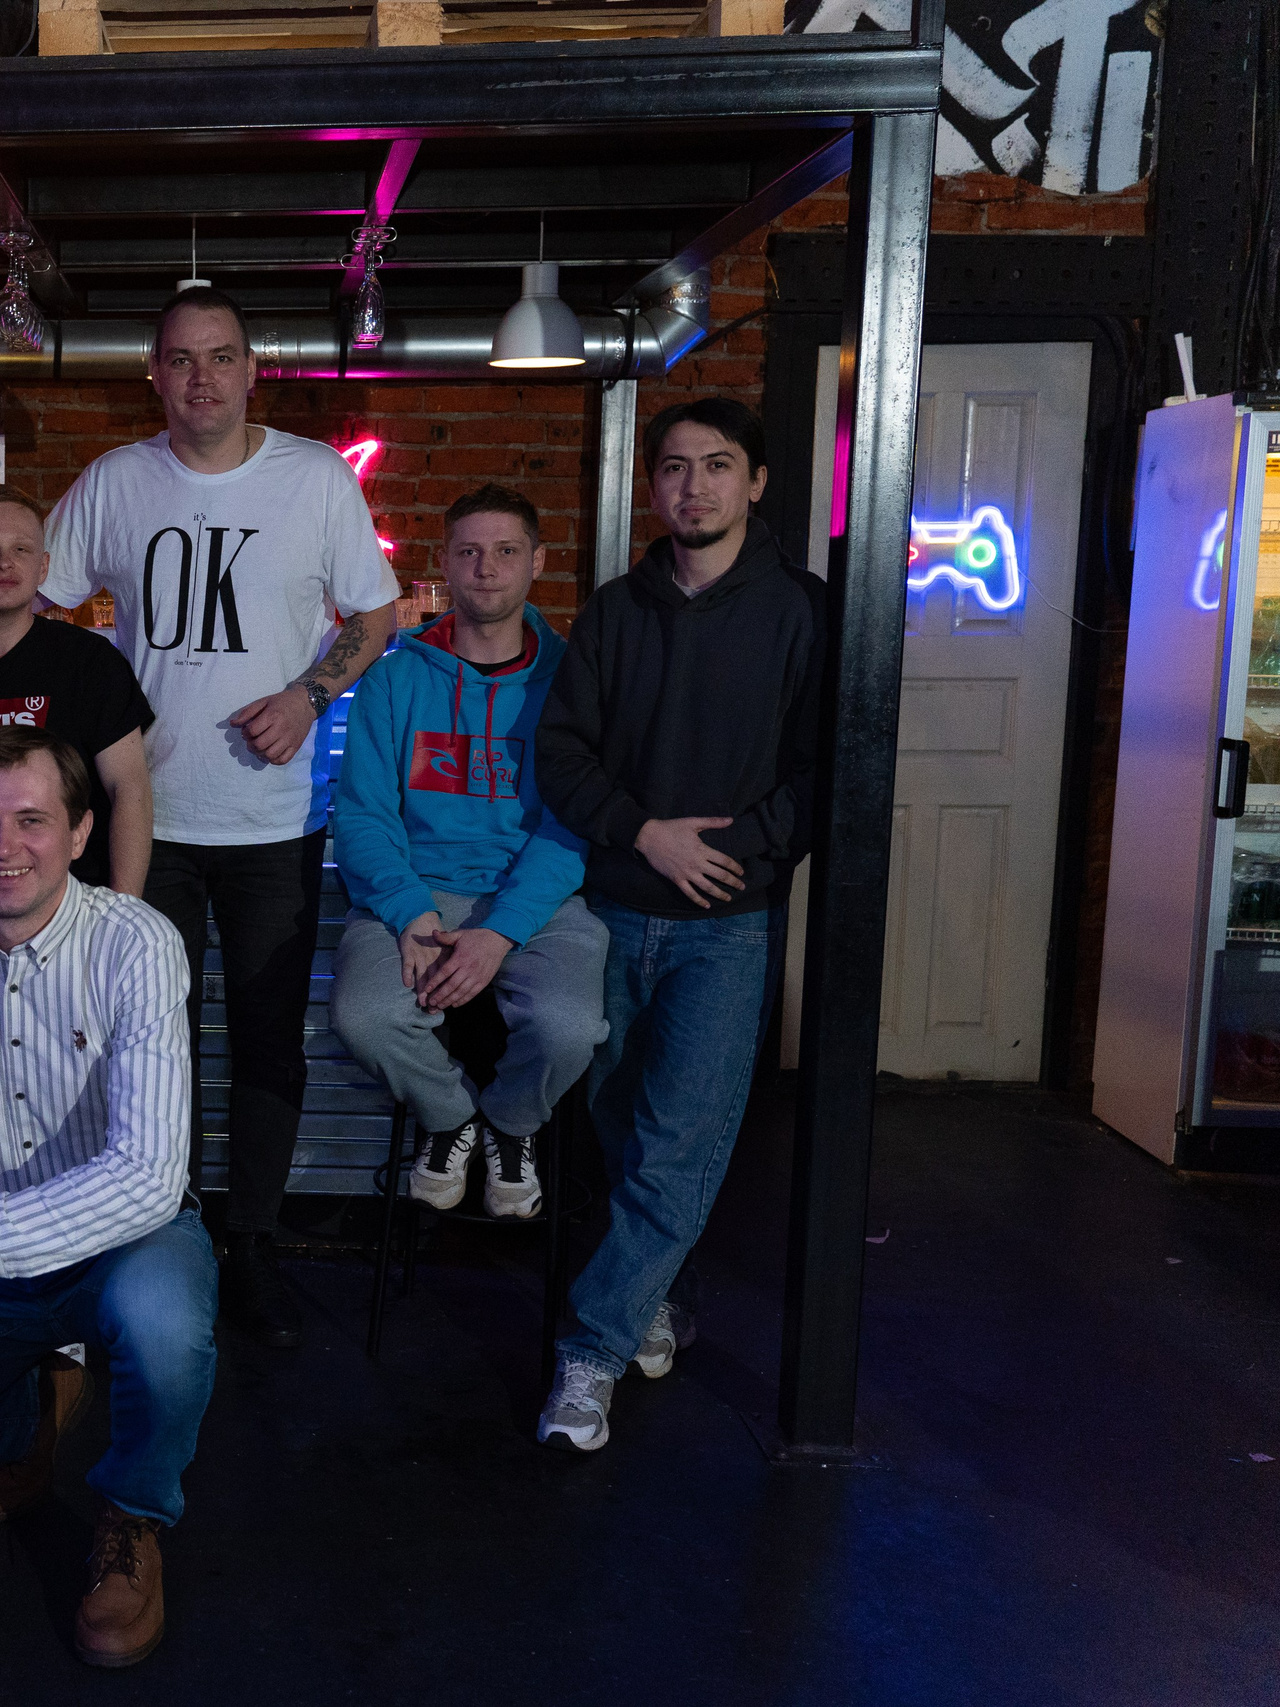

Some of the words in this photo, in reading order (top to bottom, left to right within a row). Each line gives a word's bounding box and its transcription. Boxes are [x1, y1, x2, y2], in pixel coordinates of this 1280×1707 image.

[193, 512, 207, 521] it's
[143, 526, 260, 653] OK
[472, 750, 503, 765] RP
